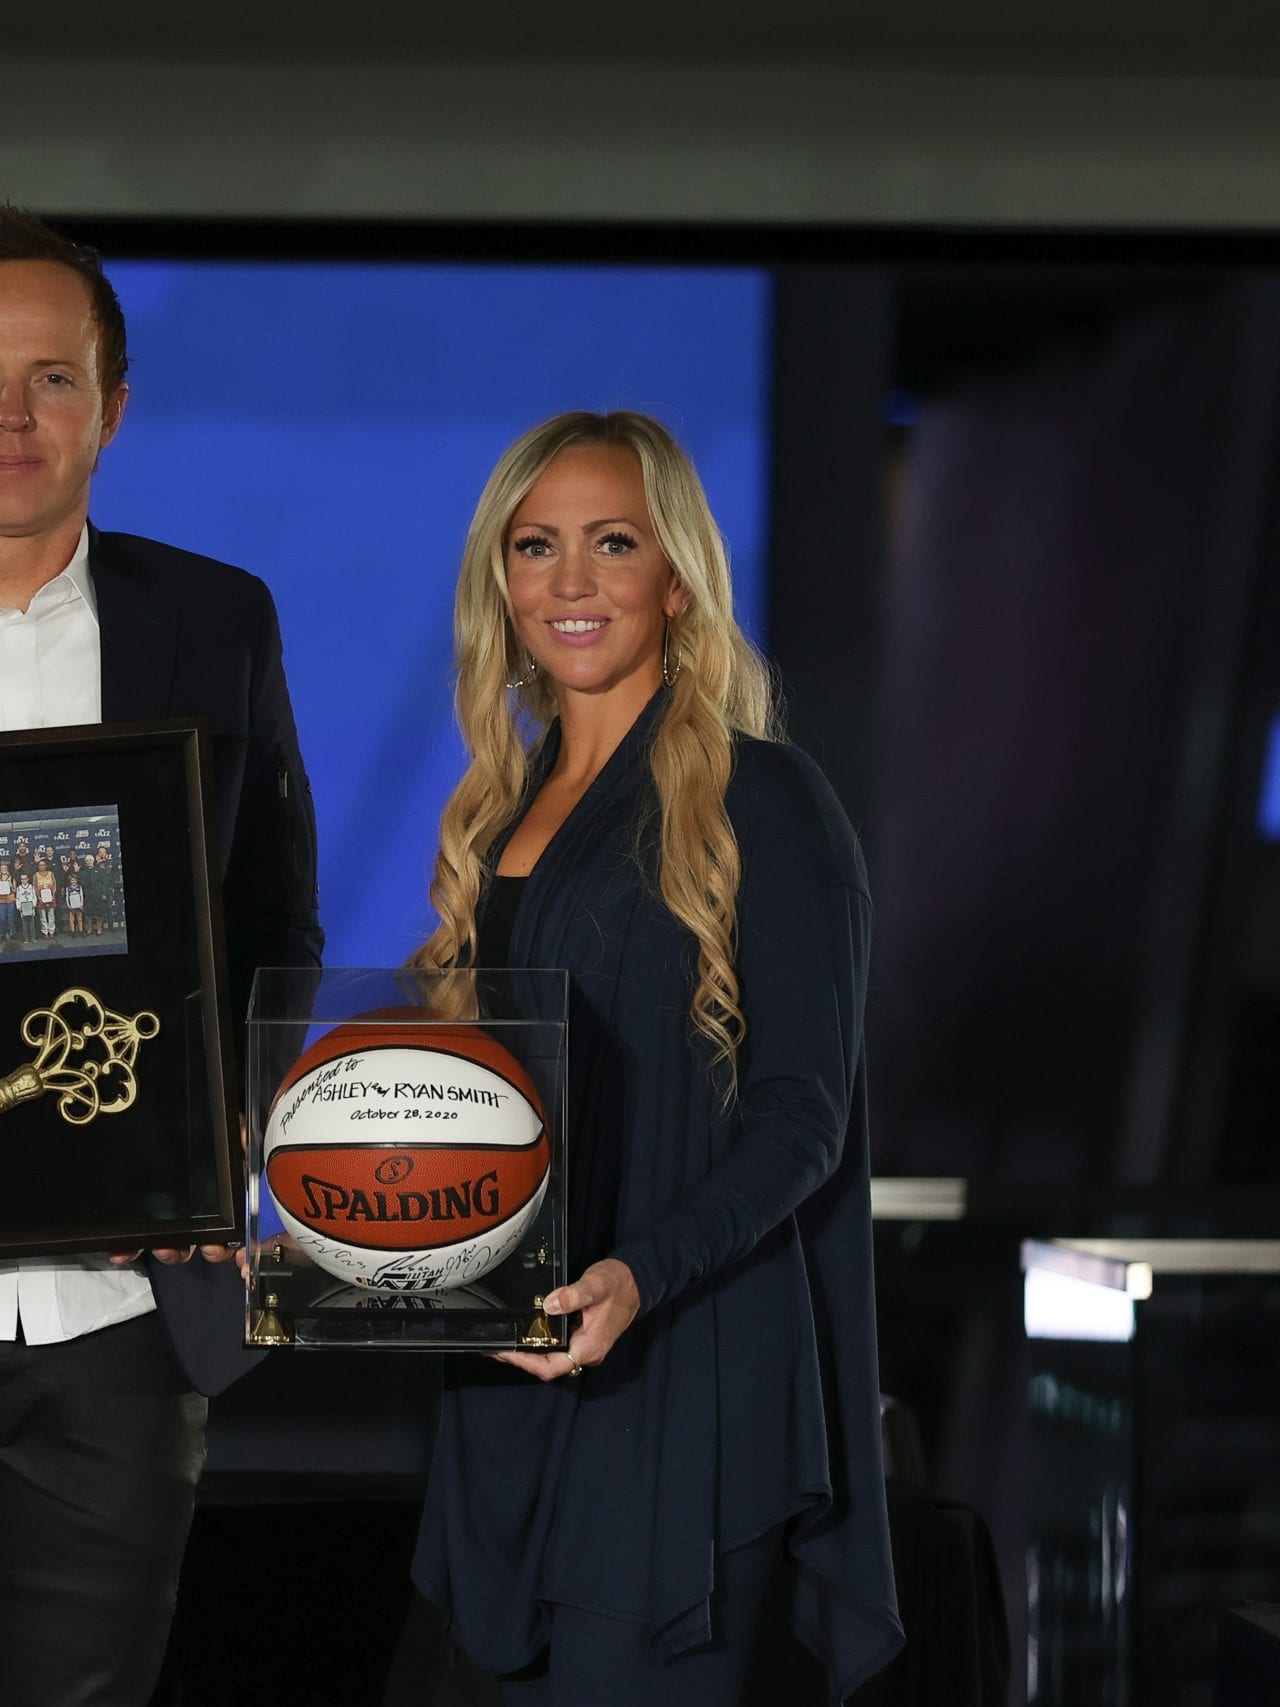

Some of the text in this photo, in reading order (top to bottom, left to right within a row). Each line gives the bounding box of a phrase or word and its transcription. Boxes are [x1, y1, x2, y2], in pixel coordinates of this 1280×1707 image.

[280, 1058, 364, 1134] Presented to
[312, 1082, 371, 1104] ASHLEY
[394, 1083, 444, 1100] RYAN
[448, 1086, 508, 1108] SMITH
[350, 1110, 458, 1120] October 28, 2020
[302, 1169, 500, 1222] SPALDING
[412, 1267, 444, 1280] UTAH
